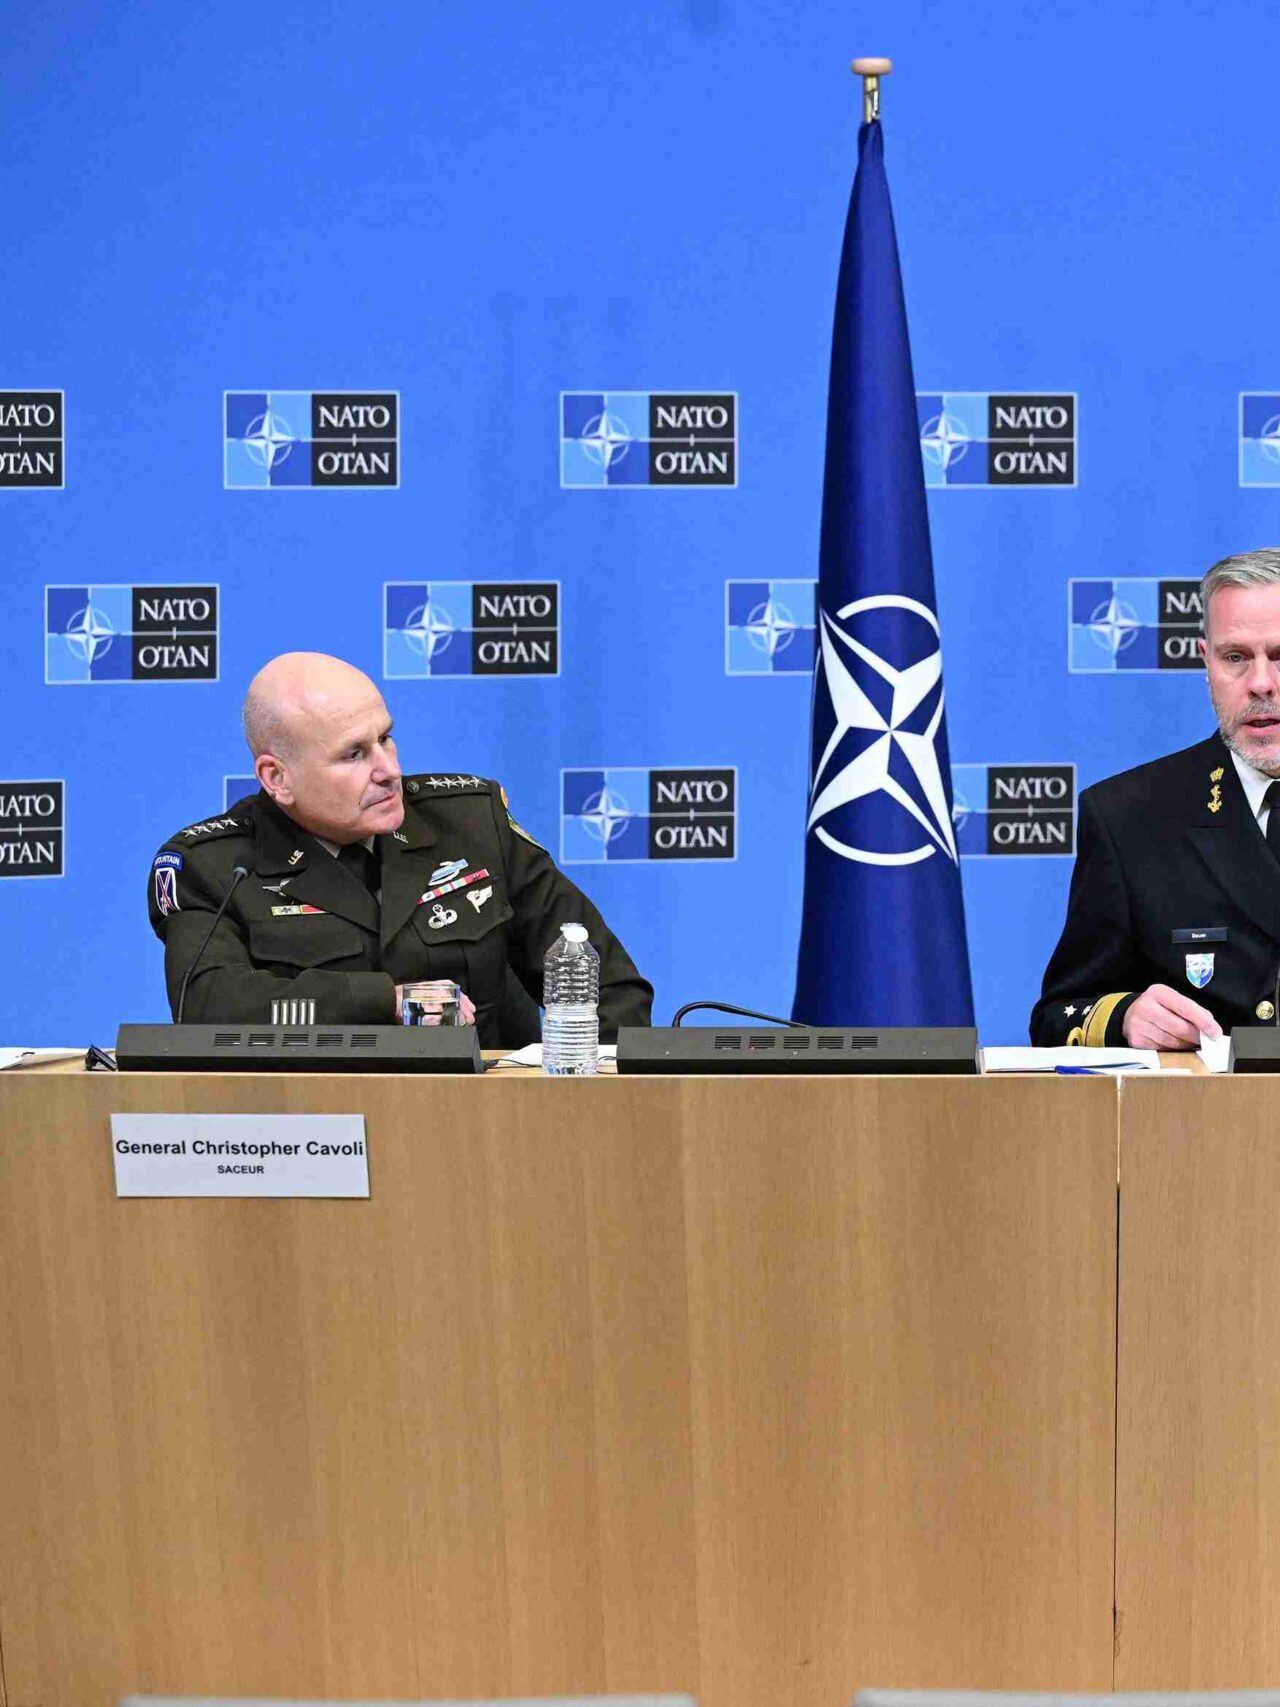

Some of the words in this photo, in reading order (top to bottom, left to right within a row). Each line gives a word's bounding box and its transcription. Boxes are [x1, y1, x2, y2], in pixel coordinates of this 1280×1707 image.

[0, 404, 55, 427] ATO
[319, 405, 390, 428] NATO
[656, 406, 728, 428] NATO
[995, 406, 1067, 428] NATO
[0, 452, 55, 474] TAN
[318, 452, 390, 475] OTAN
[655, 452, 727, 474] OTAN
[994, 451, 1067, 474] OTAN
[139, 599, 209, 621] NATO
[479, 595, 551, 617] NATO
[1166, 592, 1203, 613] NA
[138, 645, 209, 668] OTAN
[478, 641, 550, 664] OTAN
[1164, 636, 1202, 659] OT
[656, 780, 728, 803] NATO
[994, 777, 1067, 799] NATO
[0, 794, 55, 817] ATO
[655, 826, 727, 848] OTAN
[993, 822, 1066, 844] OTAN
[0, 842, 55, 864] TAN
[116, 1139, 187, 1155] General
[192, 1140, 301, 1159] Christopher
[306, 1141, 364, 1156] Cavoli
[217, 1164, 265, 1175] SACEUR
